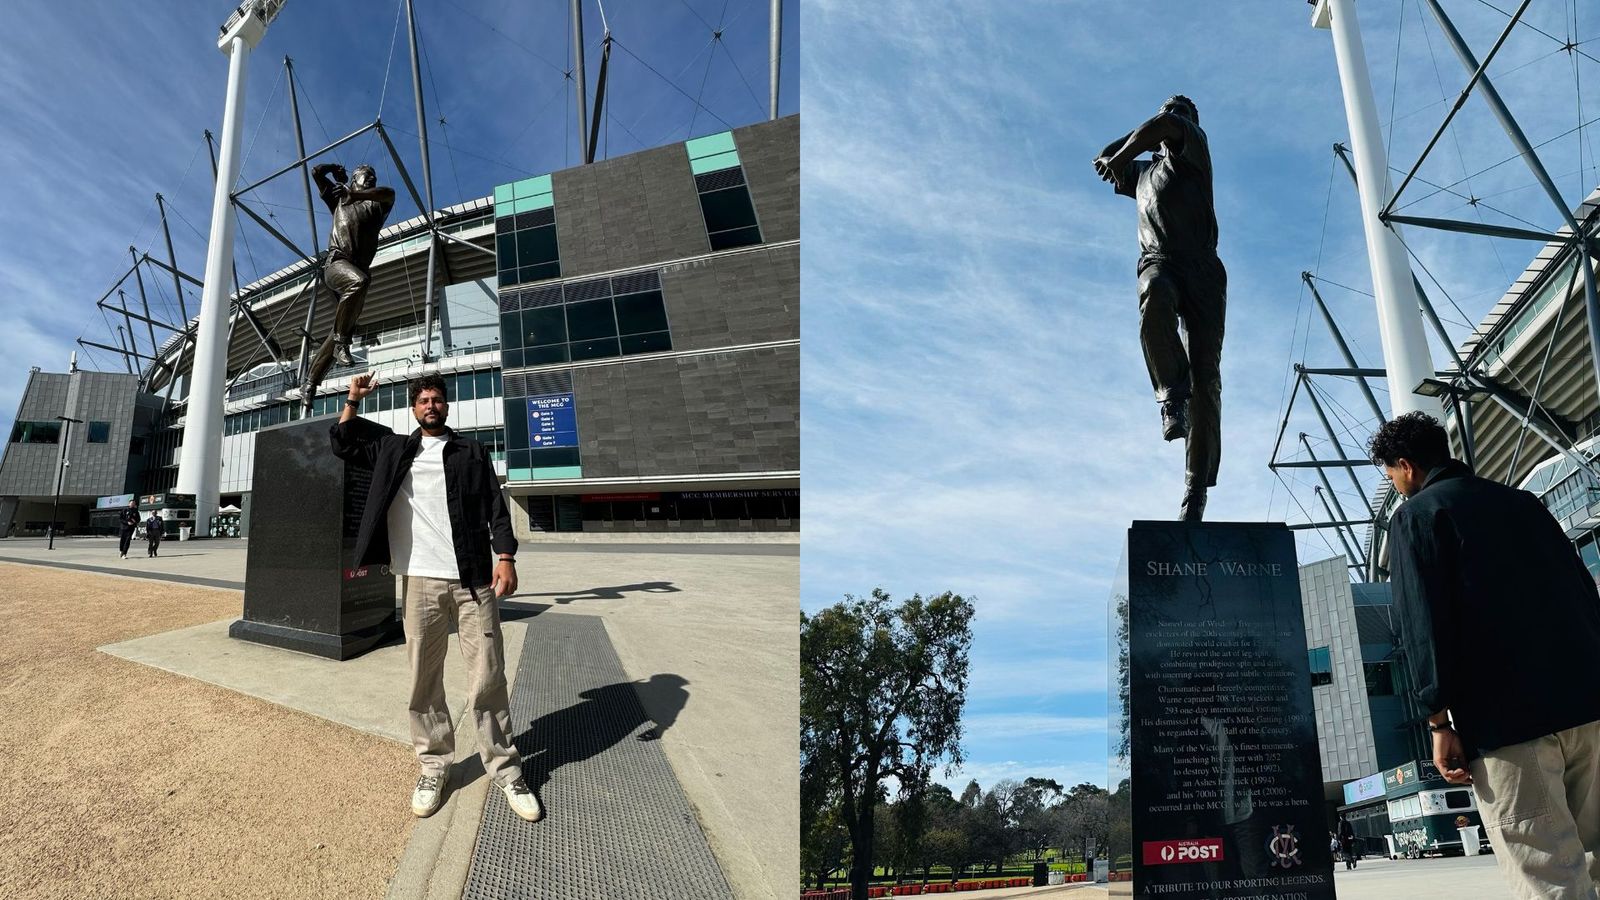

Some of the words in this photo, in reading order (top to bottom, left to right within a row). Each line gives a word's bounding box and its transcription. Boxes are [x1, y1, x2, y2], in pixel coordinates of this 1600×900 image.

[1146, 561, 1208, 576] SHANE
[1218, 562, 1282, 577] WARNE
[1160, 660, 1197, 668] combining
[1198, 660, 1236, 669] prodigious
[1237, 660, 1251, 669] spin
[1162, 672, 1192, 680] unerring
[1193, 671, 1224, 680] accuracy
[1240, 670, 1260, 678] subtle
[1157, 685, 1200, 693] Charismatic
[1216, 684, 1243, 693] fiercely
[1184, 695, 1214, 705] captured
[1230, 694, 1246, 702] Test
[1247, 694, 1273, 702] wickets
[1164, 706, 1178, 714] 293
[1180, 706, 1208, 715] one-day
[1210, 705, 1254, 713] international
[1140, 718, 1154, 726] His
[1155, 718, 1189, 726] dismissal
[1190, 717, 1199, 725] of
[1236, 716, 1255, 724] Mike
[1256, 716, 1284, 724] Gatting
[1158, 729, 1166, 737] is
[1167, 728, 1199, 739] regarded
[1223, 727, 1238, 735] Ball
[1239, 727, 1248, 735] of
[1248, 726, 1260, 734] the
[1153, 745, 1174, 754] Many
[1176, 745, 1184, 753] of
[1186, 744, 1198, 752] the
[1240, 742, 1260, 751] finest
[1173, 756, 1209, 765] launching
[1247, 754, 1264, 762] with
[1264, 753, 1281, 761] 7/52
[1183, 767, 1209, 777] destroy
[1232, 765, 1254, 774] Indies
[1194, 778, 1217, 787] Ashes
[1250, 776, 1275, 786] (1994)
[1166, 791, 1180, 800] and
[1182, 790, 1194, 799] his
[1195, 789, 1217, 798] 700th
[1262, 787, 1287, 797] (2006)
[1148, 803, 1182, 812] occurred
[1184, 803, 1191, 811] at
[1193, 802, 1205, 810] the
[1258, 799, 1267, 808] he
[1088, 850, 1093, 858] 3
[1178, 845, 1219, 860] POST
[1143, 885, 1151, 894] A
[1152, 882, 1194, 894] TRIBUTE
[1196, 881, 1209, 891] TO
[1210, 880, 1232, 890] OUR
[1233, 877, 1279, 889] SPORTING
